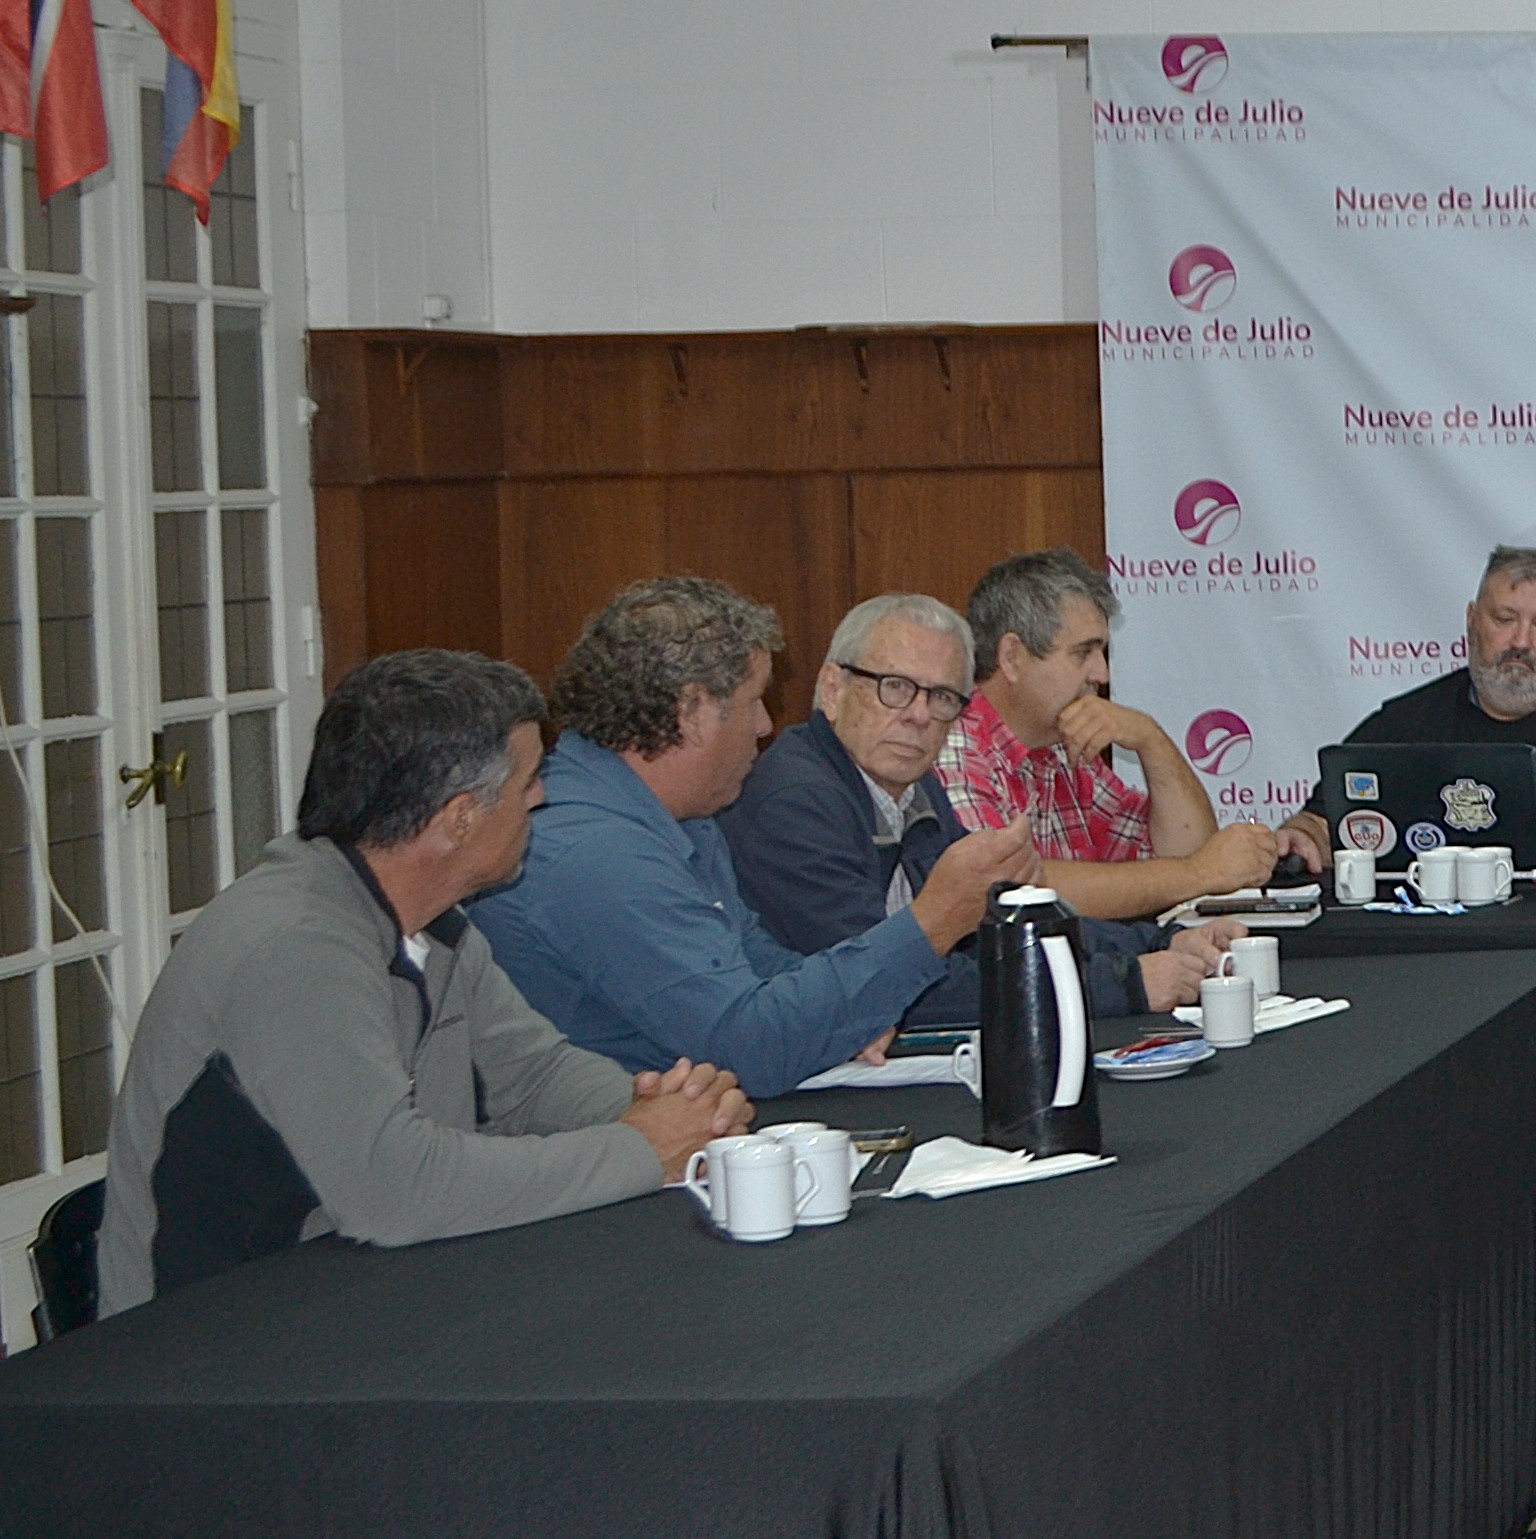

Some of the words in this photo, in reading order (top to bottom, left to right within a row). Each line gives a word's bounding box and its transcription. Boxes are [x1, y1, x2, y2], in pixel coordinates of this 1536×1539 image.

[1094, 100, 1184, 124] Nueve
[1195, 99, 1229, 124] de
[1239, 99, 1303, 124] Julio
[1096, 128, 1305, 142] MUNICIPALIDAD
[1336, 186, 1427, 210] Nueve
[1438, 185, 1472, 210] de
[1102, 320, 1191, 344] Nueve
[1203, 318, 1237, 342] de
[1247, 317, 1311, 342] Julio
[1103, 345, 1313, 360] MUNICIPALIDAD
[1345, 404, 1432, 428] Nueve
[1443, 404, 1478, 428] de
[1107, 554, 1197, 577] Nueve
[1208, 552, 1242, 575] de
[1252, 551, 1316, 575] Julio
[1350, 636, 1440, 659] Nueve
[1451, 635, 1466, 658] d
[1351, 663, 1460, 676] MUNICIP
[1219, 782, 1253, 805] de
[1264, 780, 1309, 804] Juli
